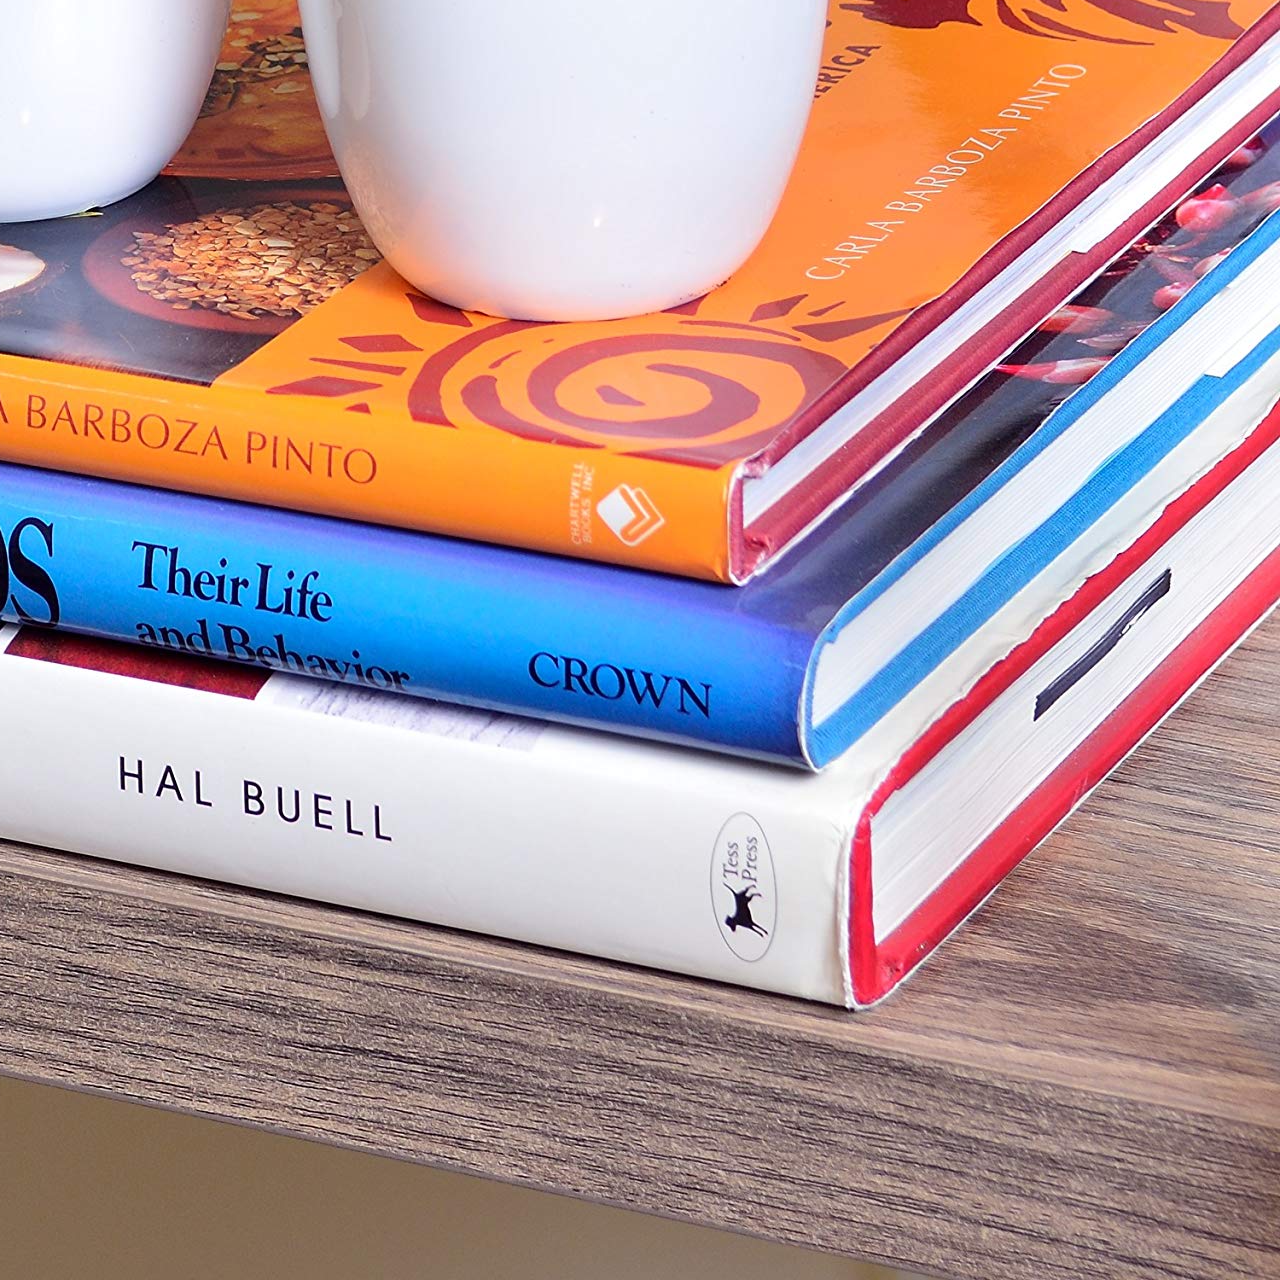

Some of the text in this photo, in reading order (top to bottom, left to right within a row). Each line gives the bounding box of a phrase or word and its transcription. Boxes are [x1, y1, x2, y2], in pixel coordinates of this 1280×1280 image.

[812, 45, 882, 103] ERICA
[805, 63, 1087, 280] CARLA BARBOZA PINTO
[26, 394, 228, 461] BARBOZA
[246, 431, 378, 485] PINTO
[131, 540, 333, 622] Their Life
[135, 618, 410, 690] and Behavior
[528, 651, 713, 719] CROWN
[119, 755, 393, 843] HAL BUELL
[722, 841, 739, 880] Tess
[741, 835, 758, 883] Press
